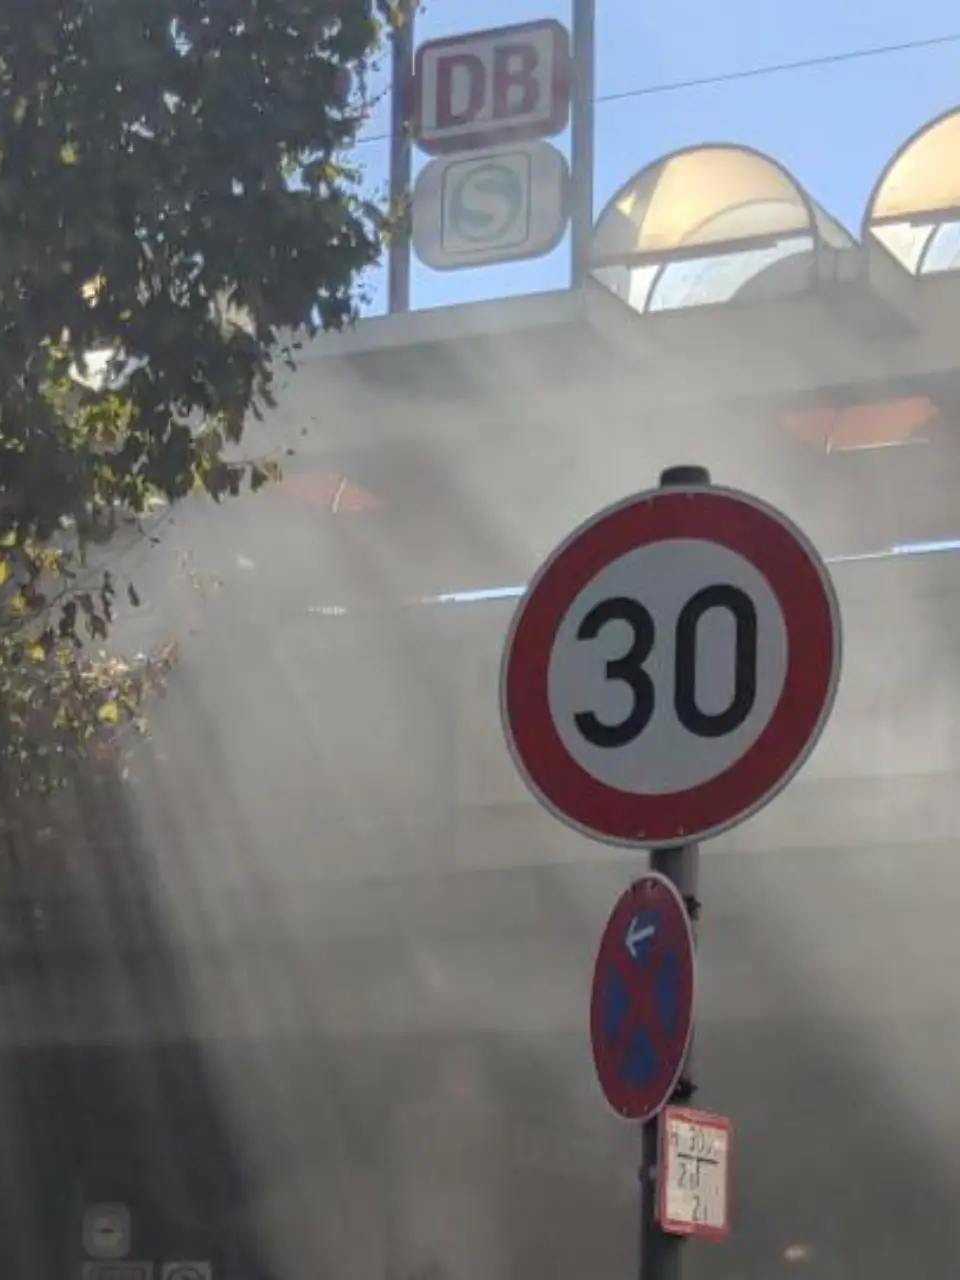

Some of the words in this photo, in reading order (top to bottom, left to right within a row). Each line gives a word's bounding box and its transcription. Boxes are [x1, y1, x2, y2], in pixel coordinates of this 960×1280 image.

[436, 42, 540, 130] DB
[456, 167, 513, 239] S
[574, 584, 757, 748] 30
